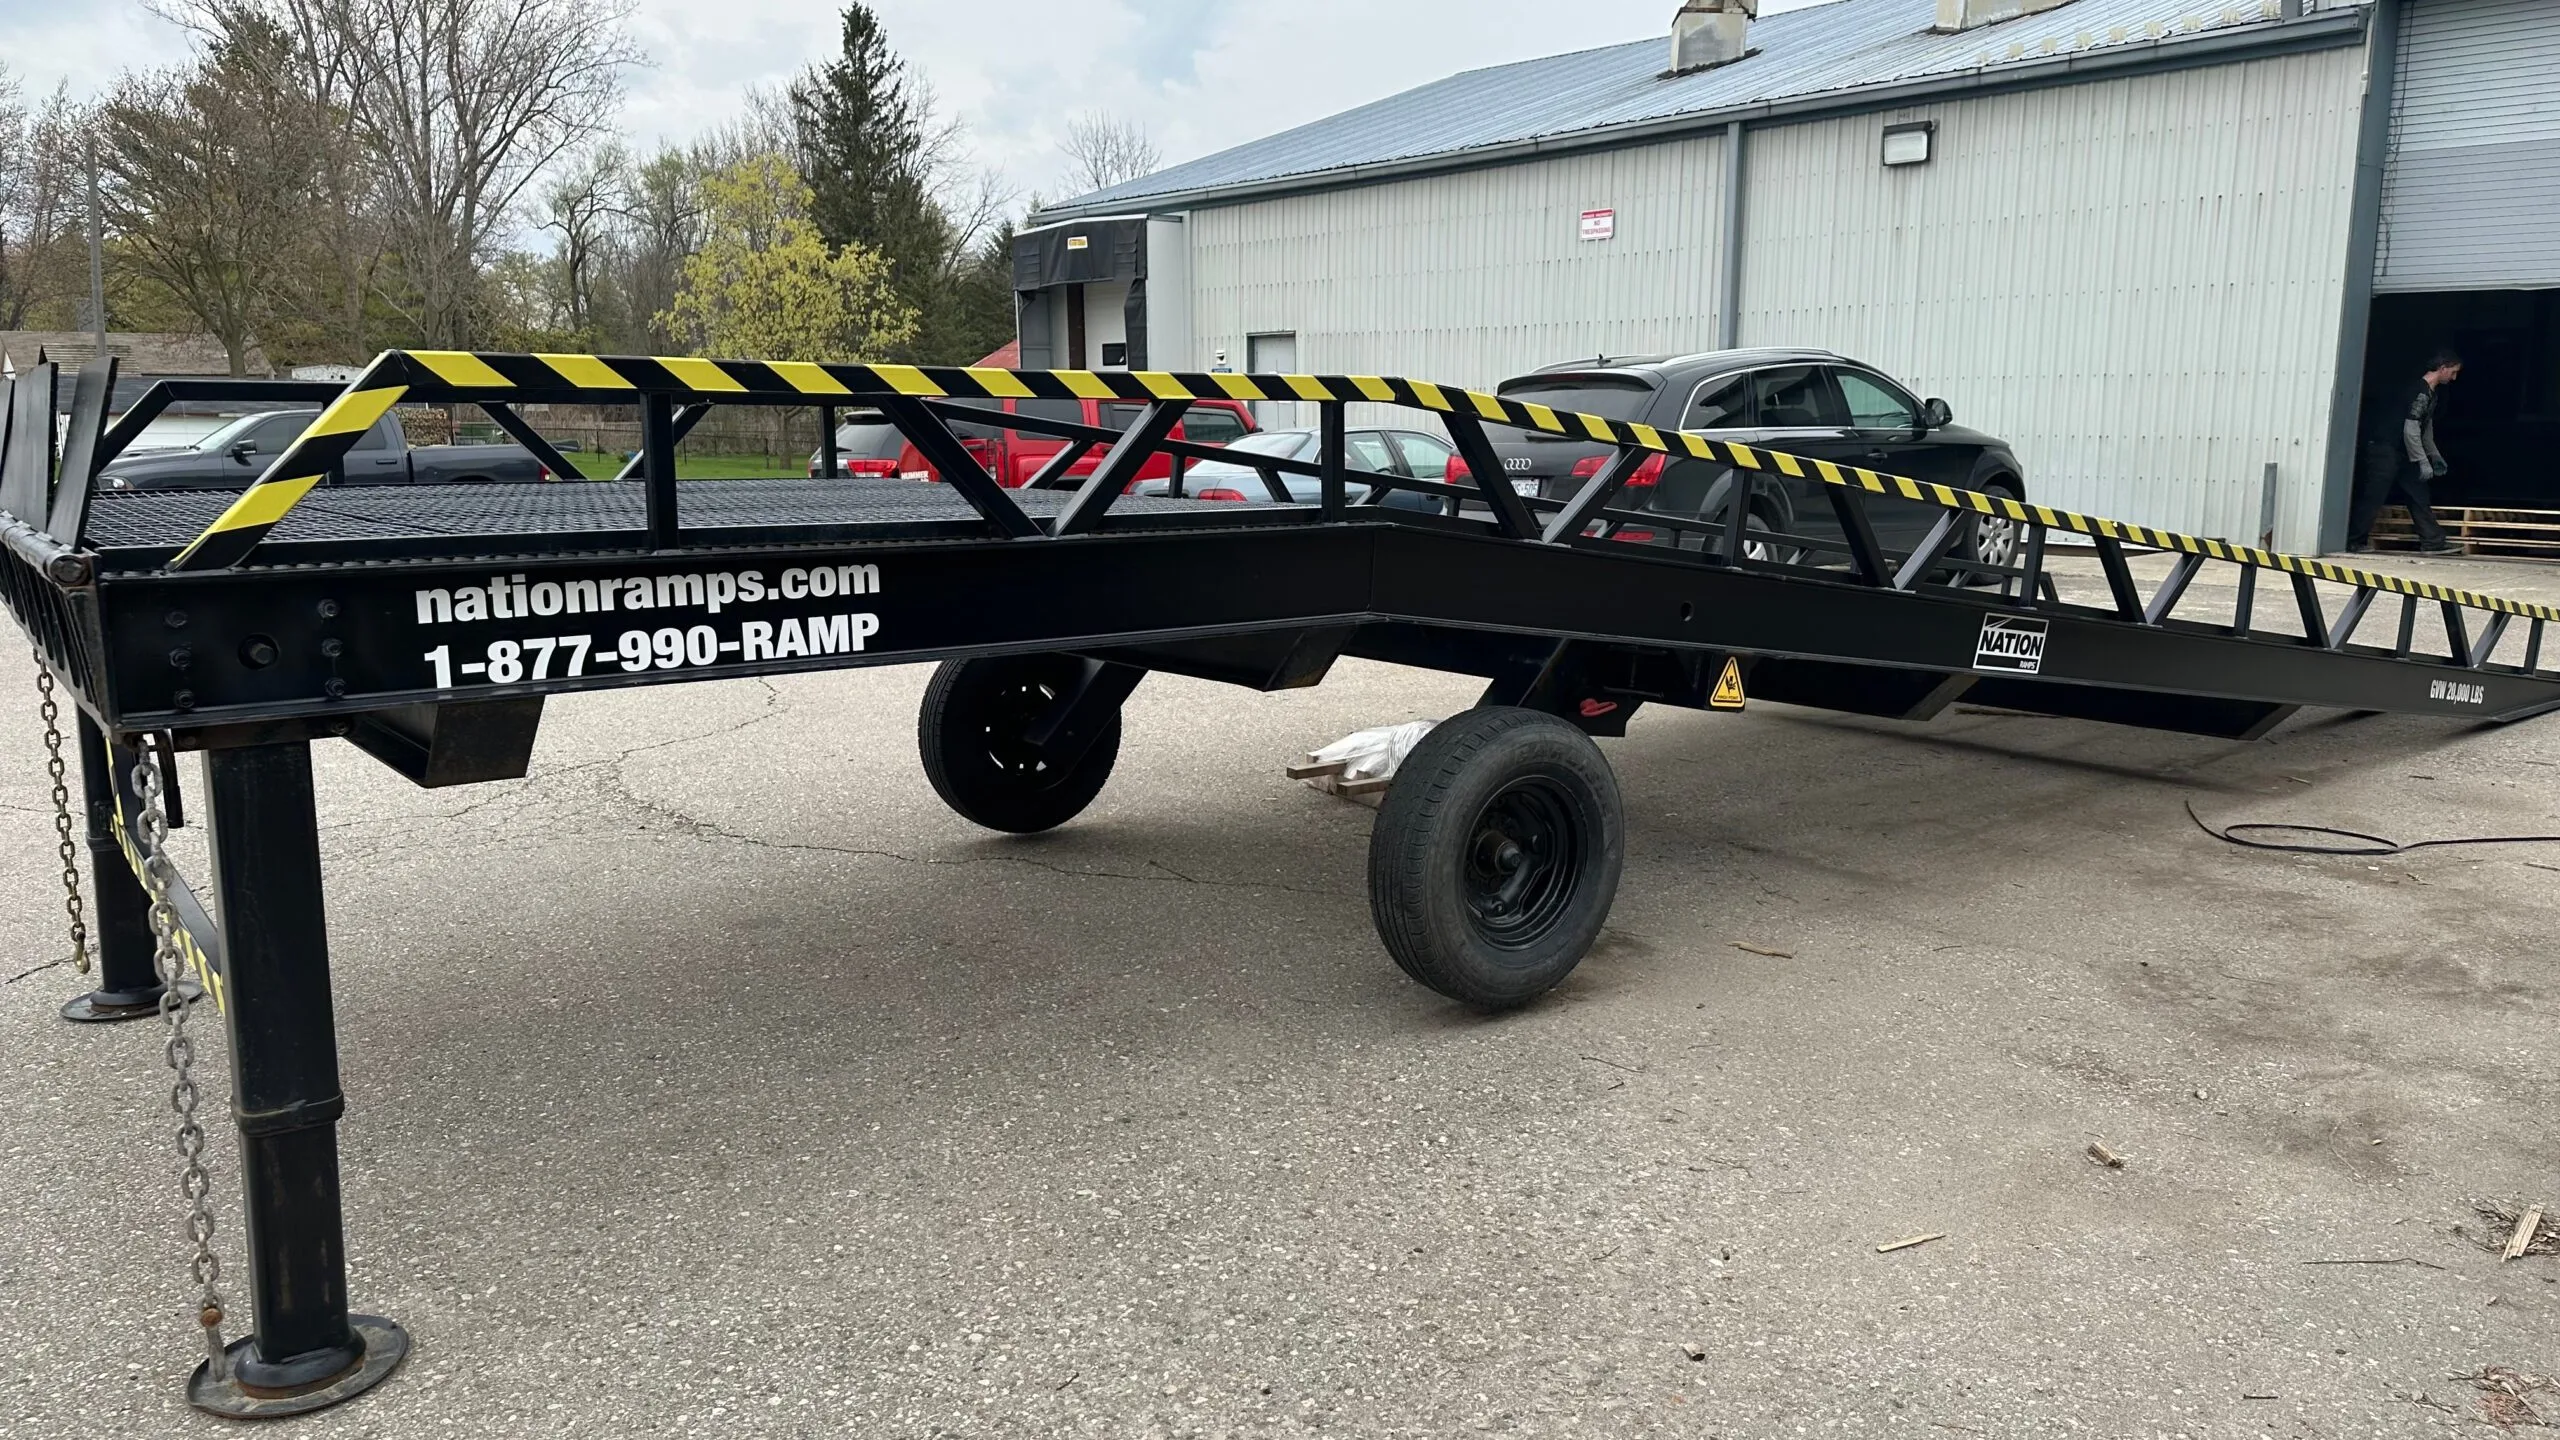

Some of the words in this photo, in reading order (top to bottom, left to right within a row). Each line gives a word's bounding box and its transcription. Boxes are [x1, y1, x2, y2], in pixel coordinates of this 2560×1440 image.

[415, 563, 881, 625] nationramps.com
[424, 612, 881, 689] 1-877-990-RAMP
[1979, 630, 2044, 657] NATION
[2430, 679, 2448, 699] GVW
[2446, 681, 2471, 704] 20,000
[2470, 684, 2485, 704] LBS
